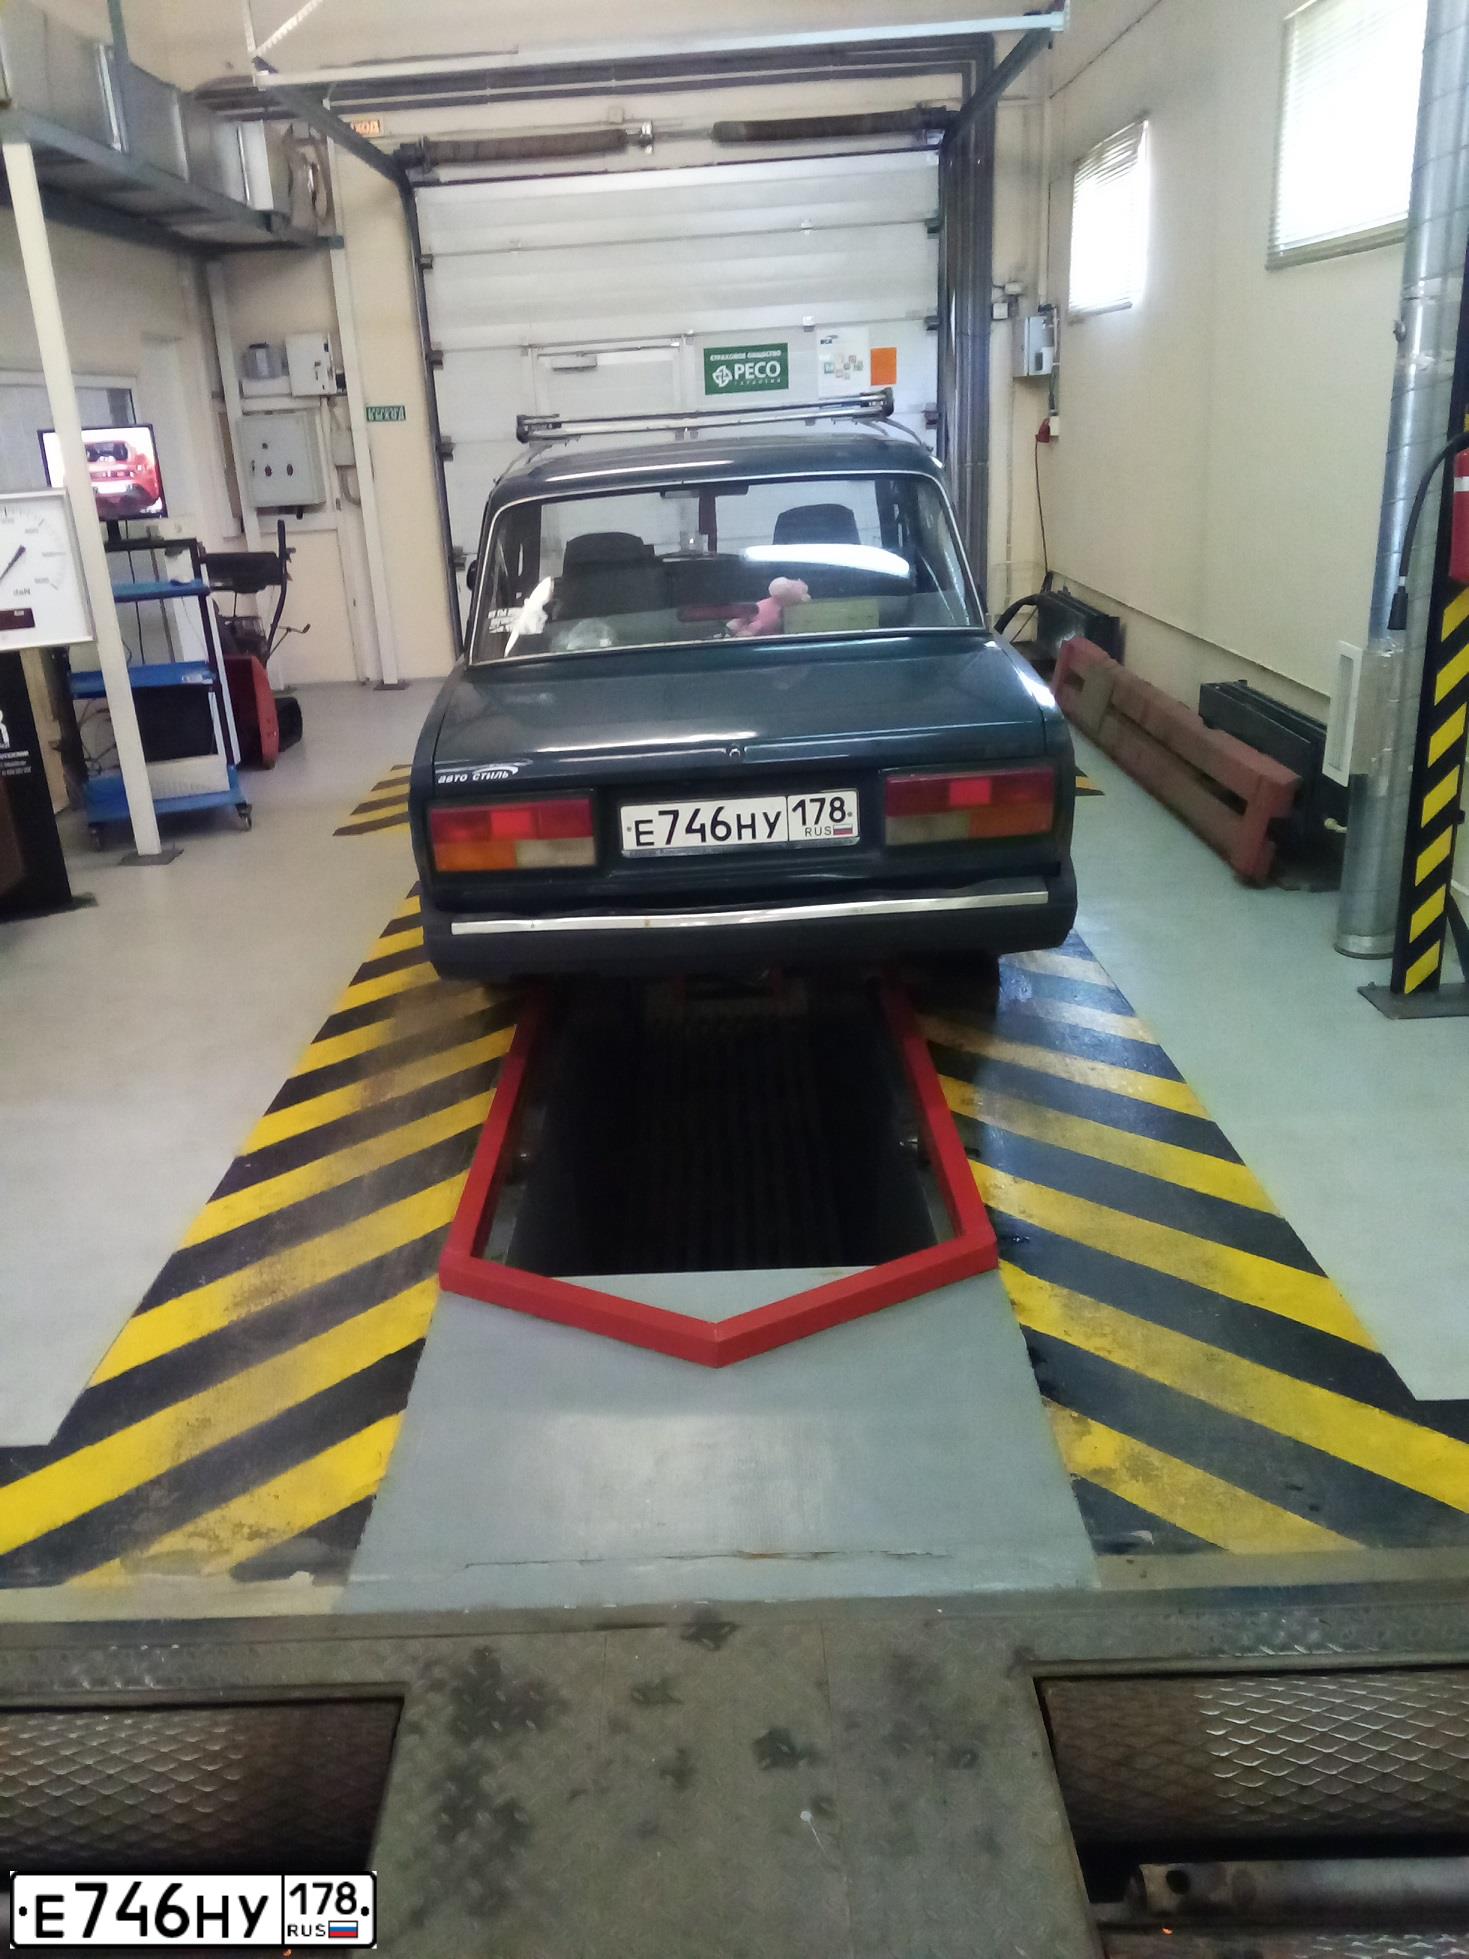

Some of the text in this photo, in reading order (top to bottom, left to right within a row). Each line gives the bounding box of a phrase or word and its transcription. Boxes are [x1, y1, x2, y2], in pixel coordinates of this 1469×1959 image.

[634, 796, 847, 847] Е746НУ 178
[804, 825, 832, 837] RUS
